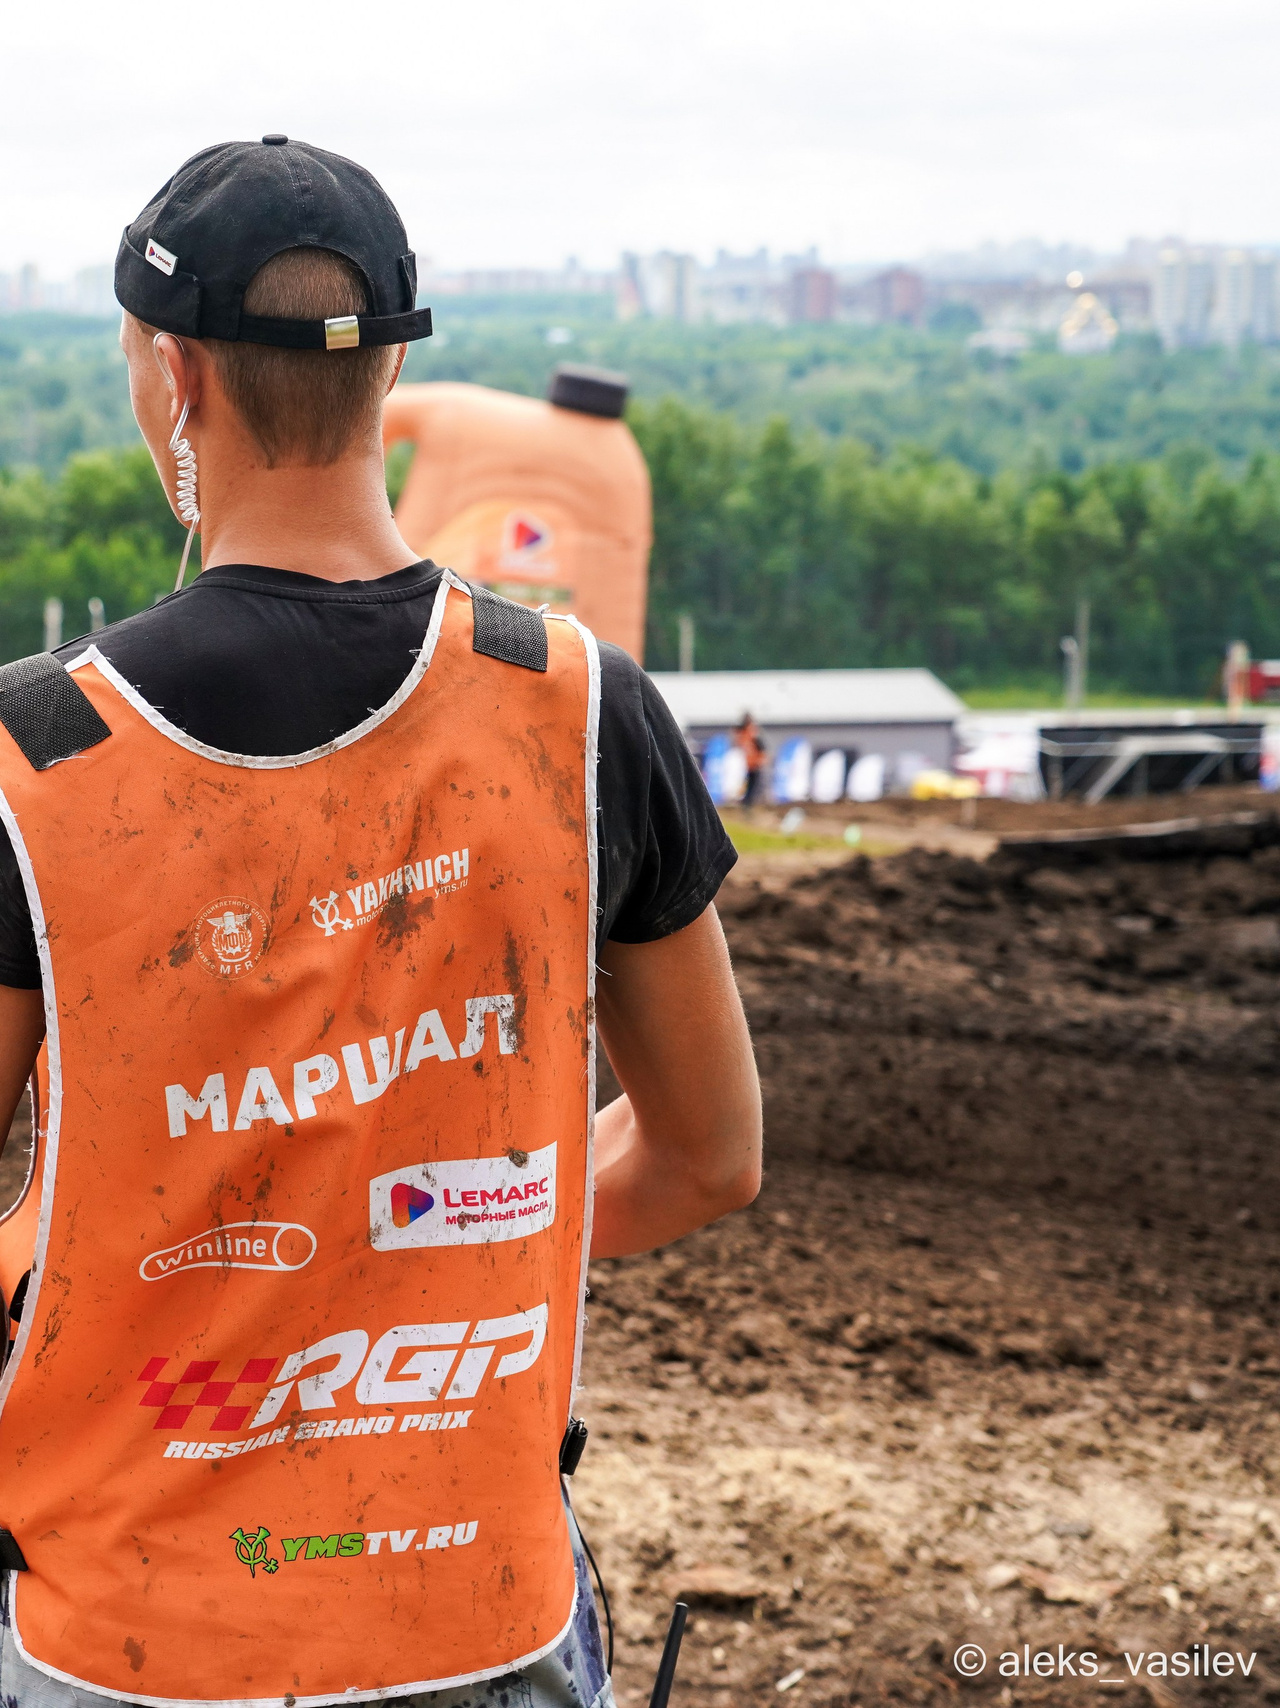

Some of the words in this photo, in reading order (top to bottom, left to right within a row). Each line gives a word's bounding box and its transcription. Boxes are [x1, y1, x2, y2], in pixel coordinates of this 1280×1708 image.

[346, 848, 469, 916] YAKHNICH
[220, 960, 254, 974] MFR
[165, 994, 518, 1139] МАРШАЛ
[443, 1177, 548, 1208] LEMARC
[445, 1210, 516, 1225] МОТОРНЫЕ
[518, 1200, 548, 1217] МАСЛА
[156, 1234, 267, 1271] winline
[249, 1303, 549, 1430] RGP
[162, 1425, 291, 1460] RUSSIAN
[294, 1415, 396, 1440] GRAND
[399, 1409, 475, 1433] PRIX
[281, 1520, 479, 1561] YMSTV.RU
